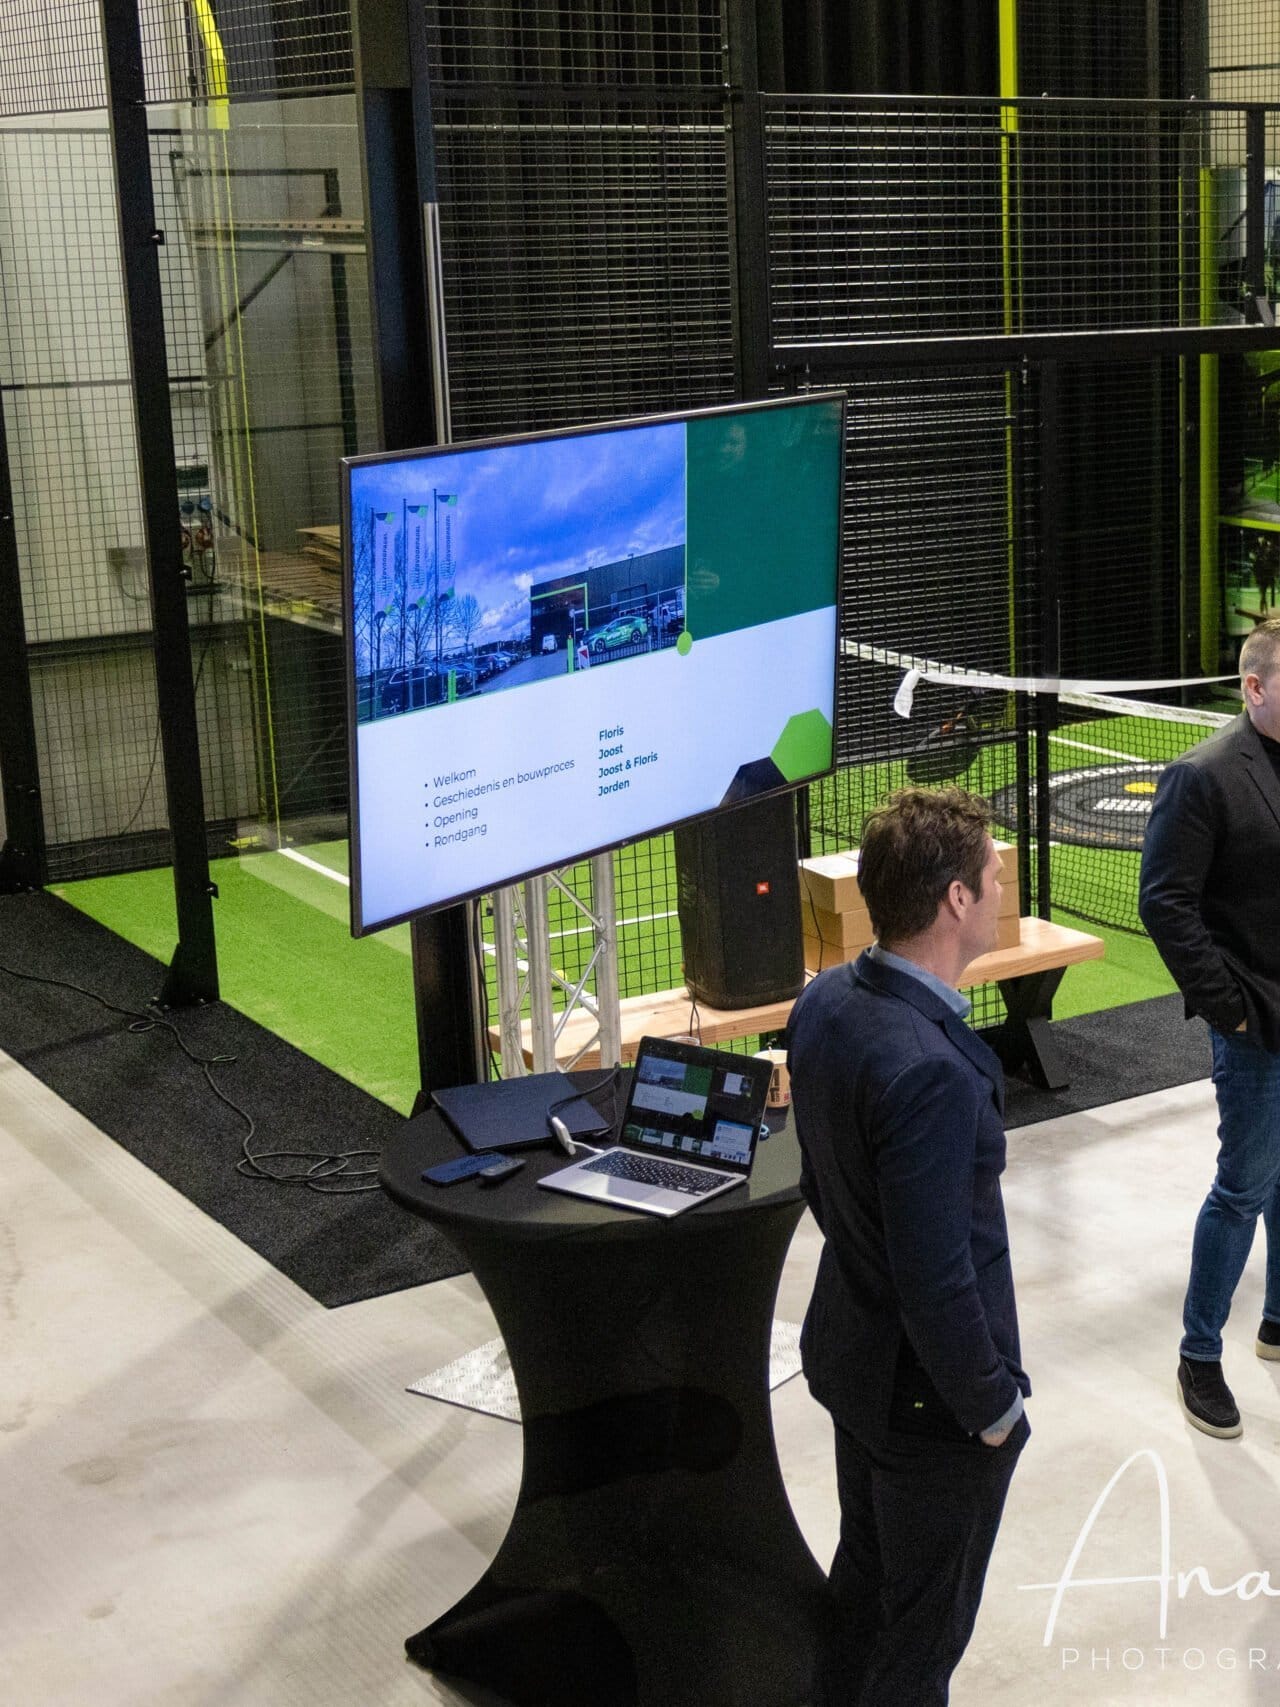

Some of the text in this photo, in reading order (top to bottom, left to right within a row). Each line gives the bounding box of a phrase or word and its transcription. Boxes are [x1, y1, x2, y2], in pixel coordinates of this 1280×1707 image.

[599, 725, 624, 741] Floris
[598, 744, 623, 760] Joost
[598, 751, 658, 778] Joost & Floris
[433, 768, 477, 788] Welkom
[433, 759, 575, 808] Geschiedenis en bouwproces
[598, 779, 630, 797] Jorden
[433, 807, 479, 828] Opening
[434, 823, 488, 848] Rondgang
